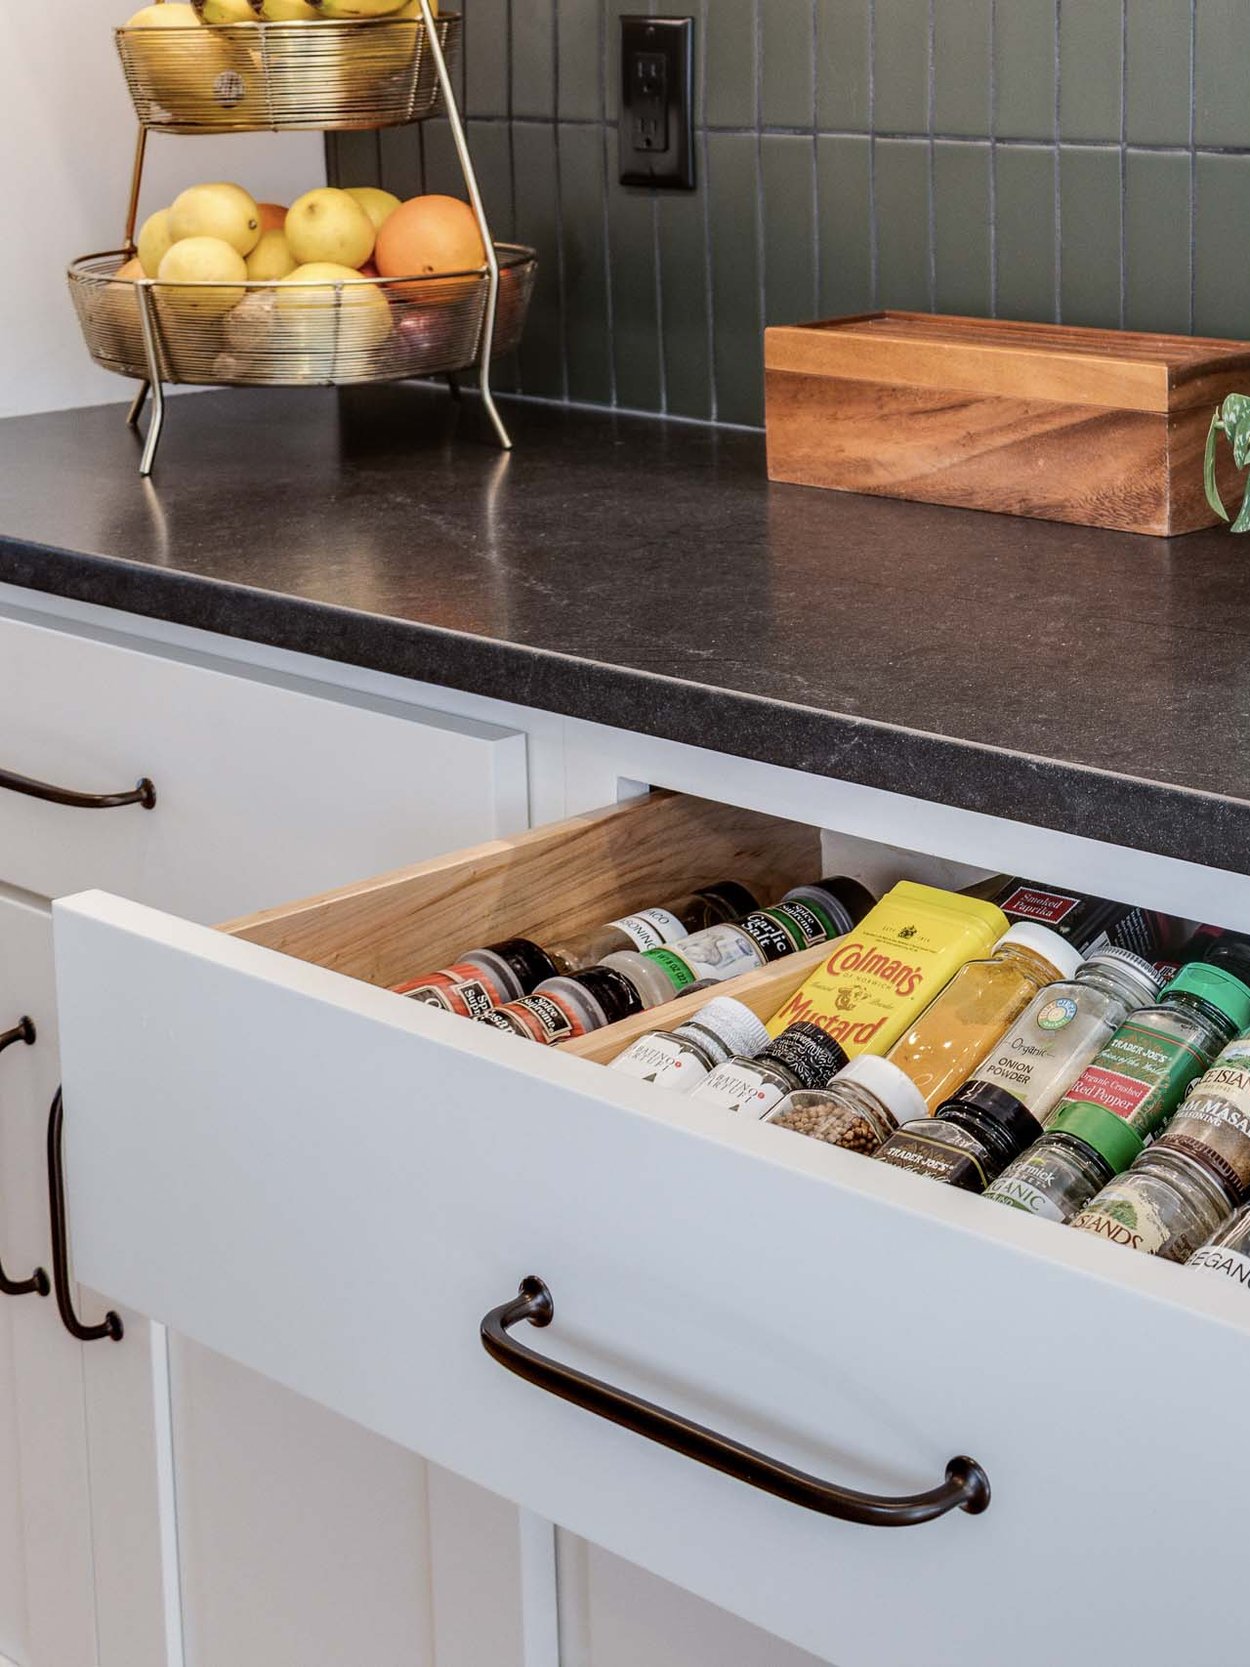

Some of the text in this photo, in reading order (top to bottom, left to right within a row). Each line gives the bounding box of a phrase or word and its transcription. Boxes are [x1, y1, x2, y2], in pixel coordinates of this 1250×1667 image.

[1013, 900, 1053, 917] Paprika
[1024, 893, 1063, 909] Smoked
[783, 905, 813, 934] Supreme
[793, 905, 815, 924] Spice
[741, 920, 770, 947] Salt
[747, 914, 787, 952] Garlic
[827, 943, 923, 997] Colman's
[535, 998, 558, 1017] Spice
[779, 992, 889, 1044] Mustard
[1011, 1037, 1048, 1058] Organic
[1111, 1039, 1168, 1063] TRADER JOE'S
[987, 1065, 1031, 1084] POWDER
[999, 1057, 1034, 1074] ONION
[1072, 1080, 1134, 1110] Red Pepper
[1082, 1071, 1142, 1098] Organic Crushed
[887, 1147, 924, 1164] TRADER
[921, 1158, 949, 1172] JOE'S
